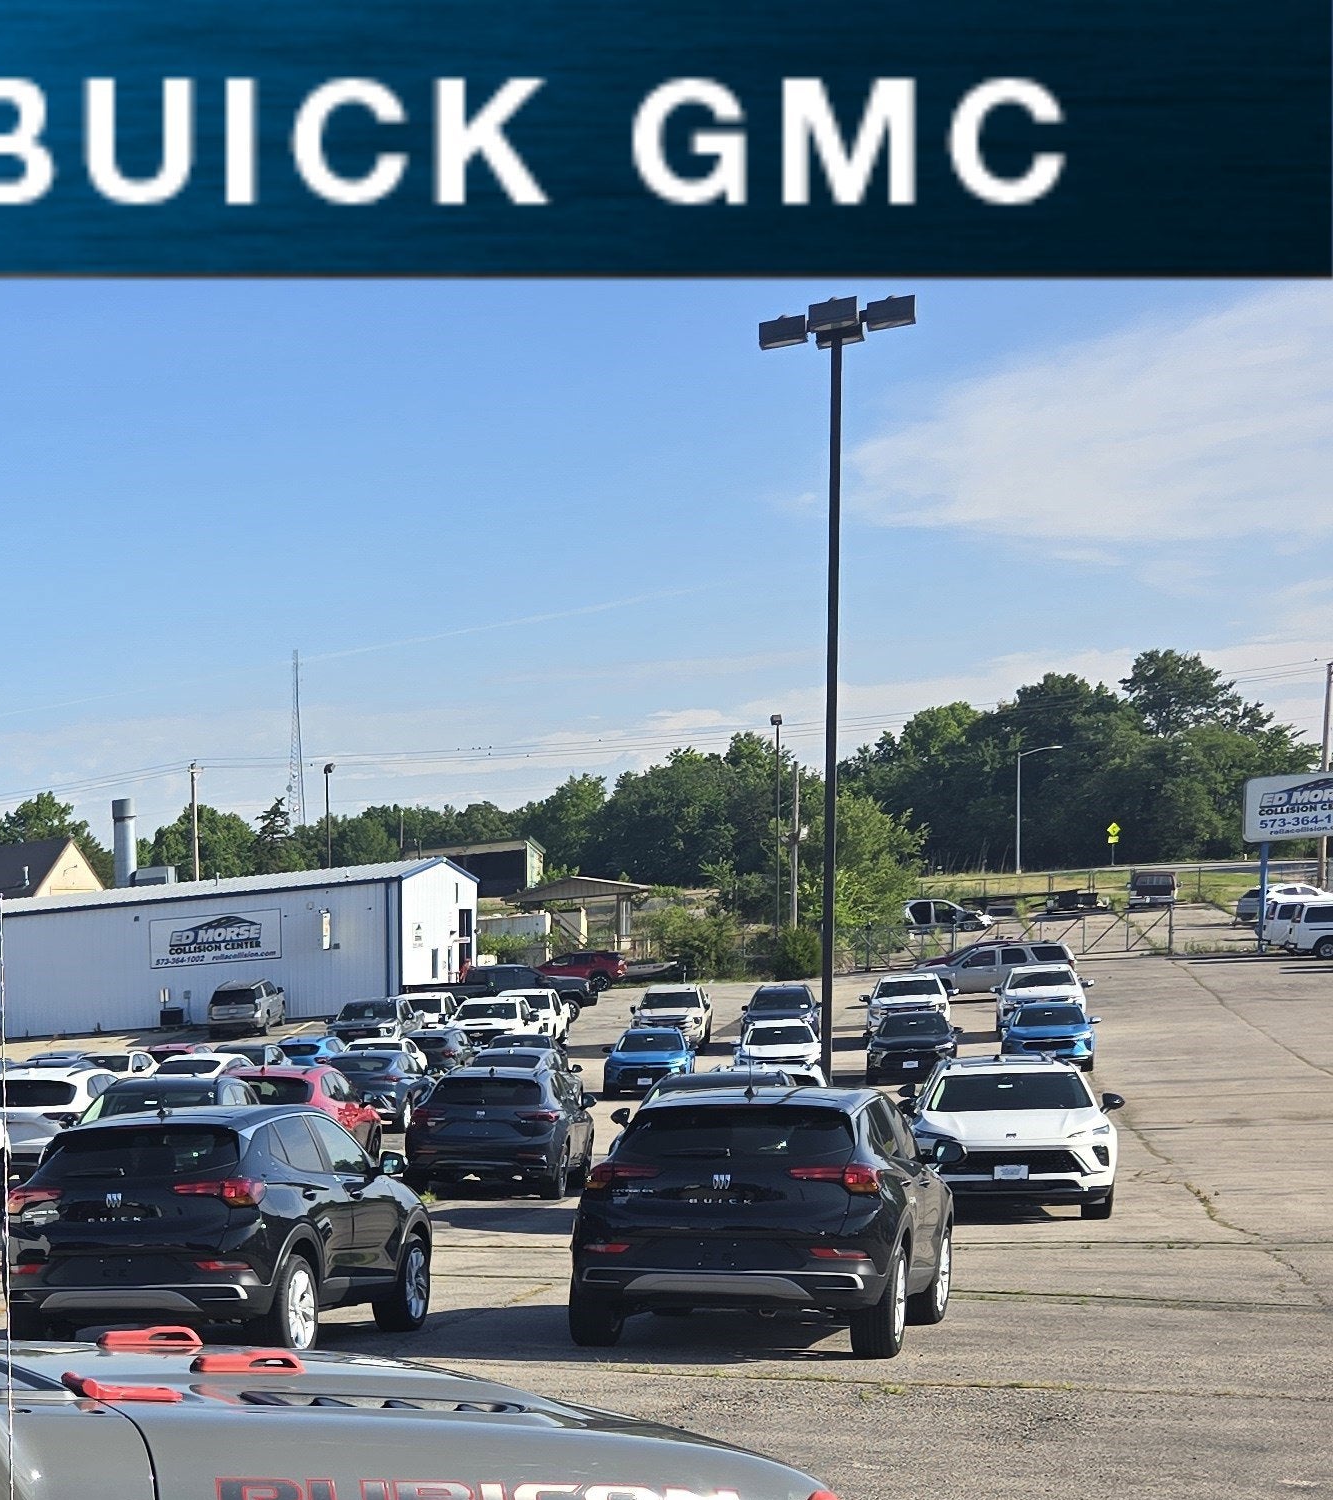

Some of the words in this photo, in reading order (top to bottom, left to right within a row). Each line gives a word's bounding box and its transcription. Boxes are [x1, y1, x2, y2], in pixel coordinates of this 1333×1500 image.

[1260, 793, 1288, 807] ED
[1258, 804, 1318, 817] COLLISION
[1259, 814, 1332, 829] 573-364-1
[170, 931, 194, 946] ED
[196, 923, 262, 944] MORSE
[169, 944, 222, 955] COLLISION
[224, 940, 262, 951] CENTER
